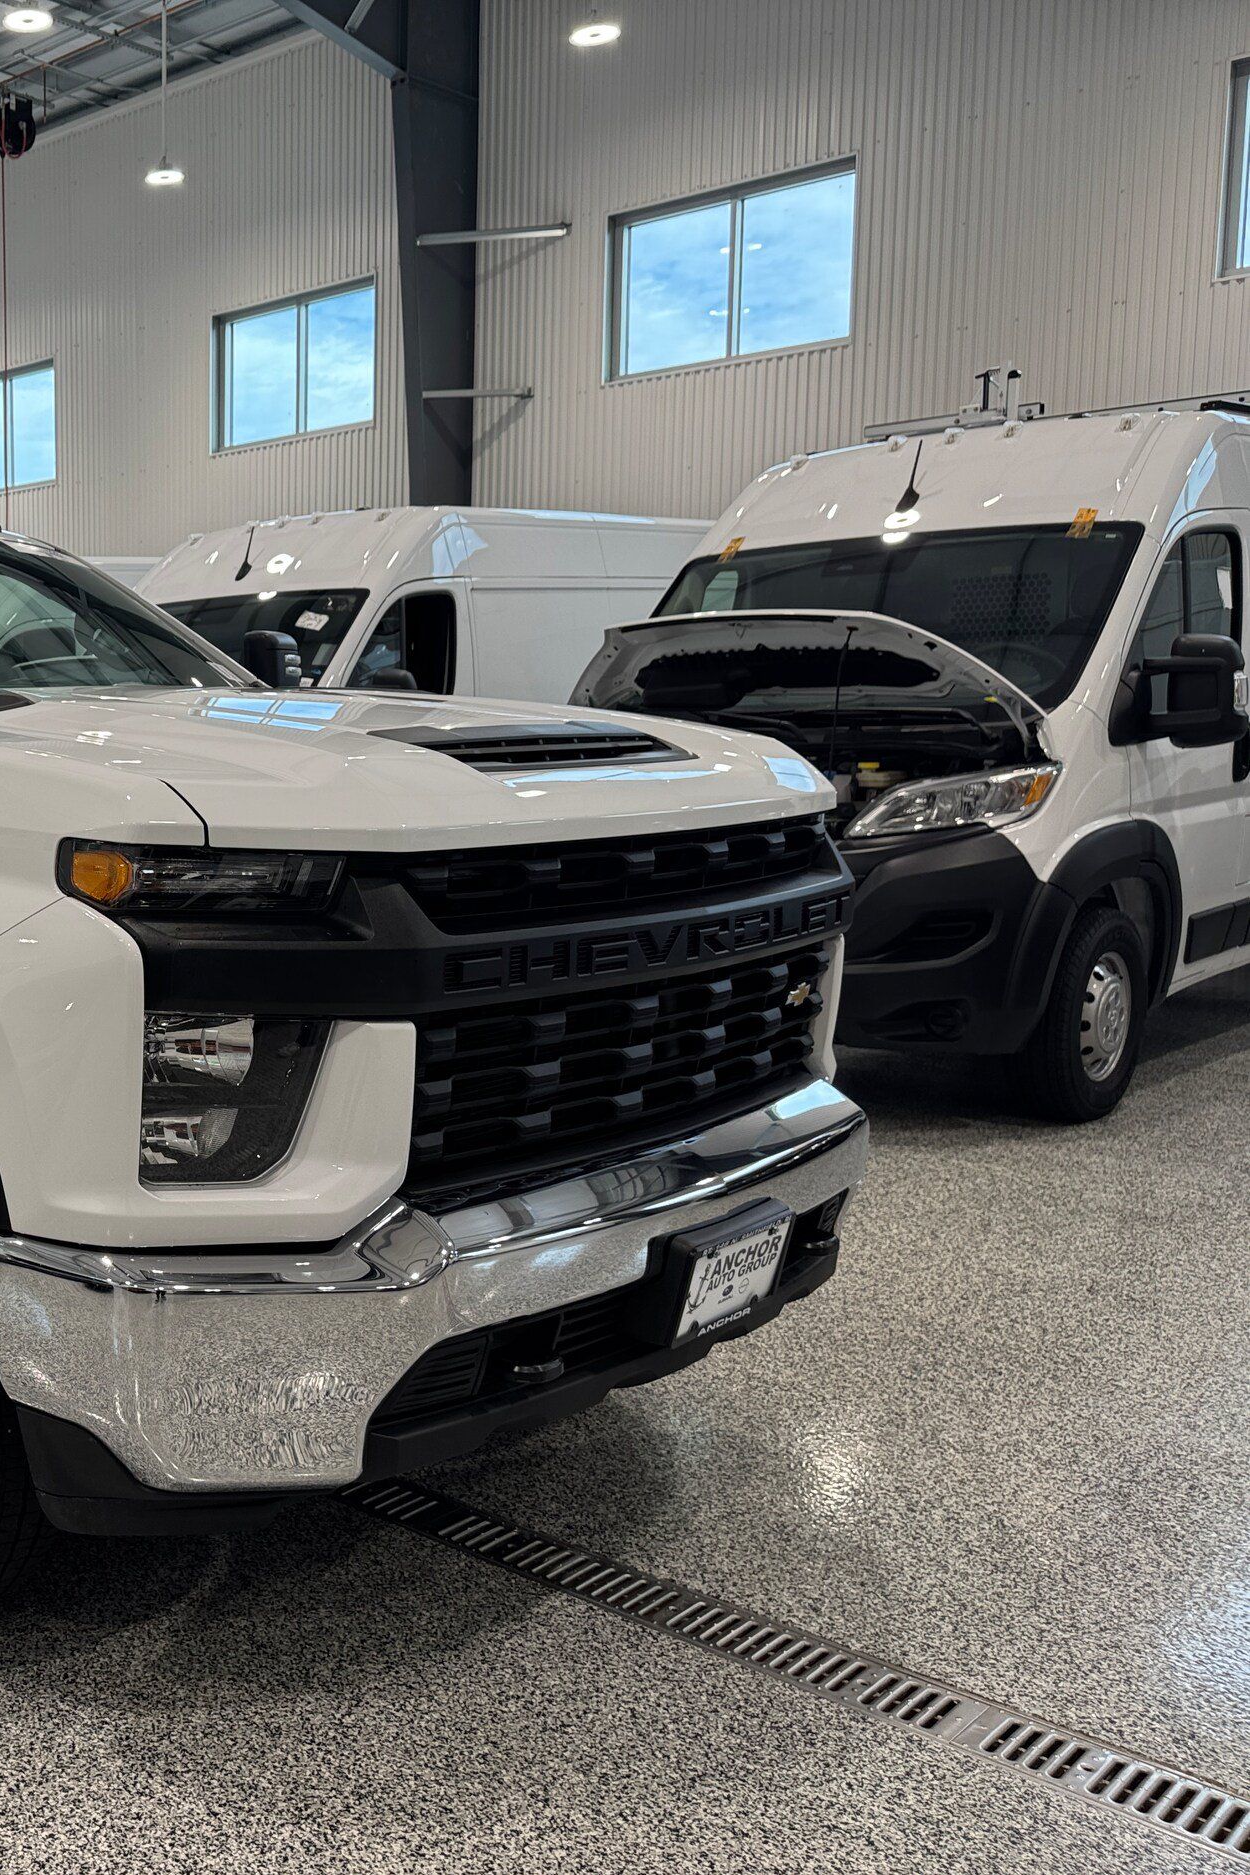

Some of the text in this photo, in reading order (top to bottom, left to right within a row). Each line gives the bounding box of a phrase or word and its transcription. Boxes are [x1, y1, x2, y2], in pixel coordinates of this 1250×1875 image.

[443, 896, 850, 994] CHEVROLET
[706, 1252, 778, 1293] AUTO GROUP
[710, 1235, 782, 1279] ANCHOR
[696, 1306, 752, 1337] ANCHOR
